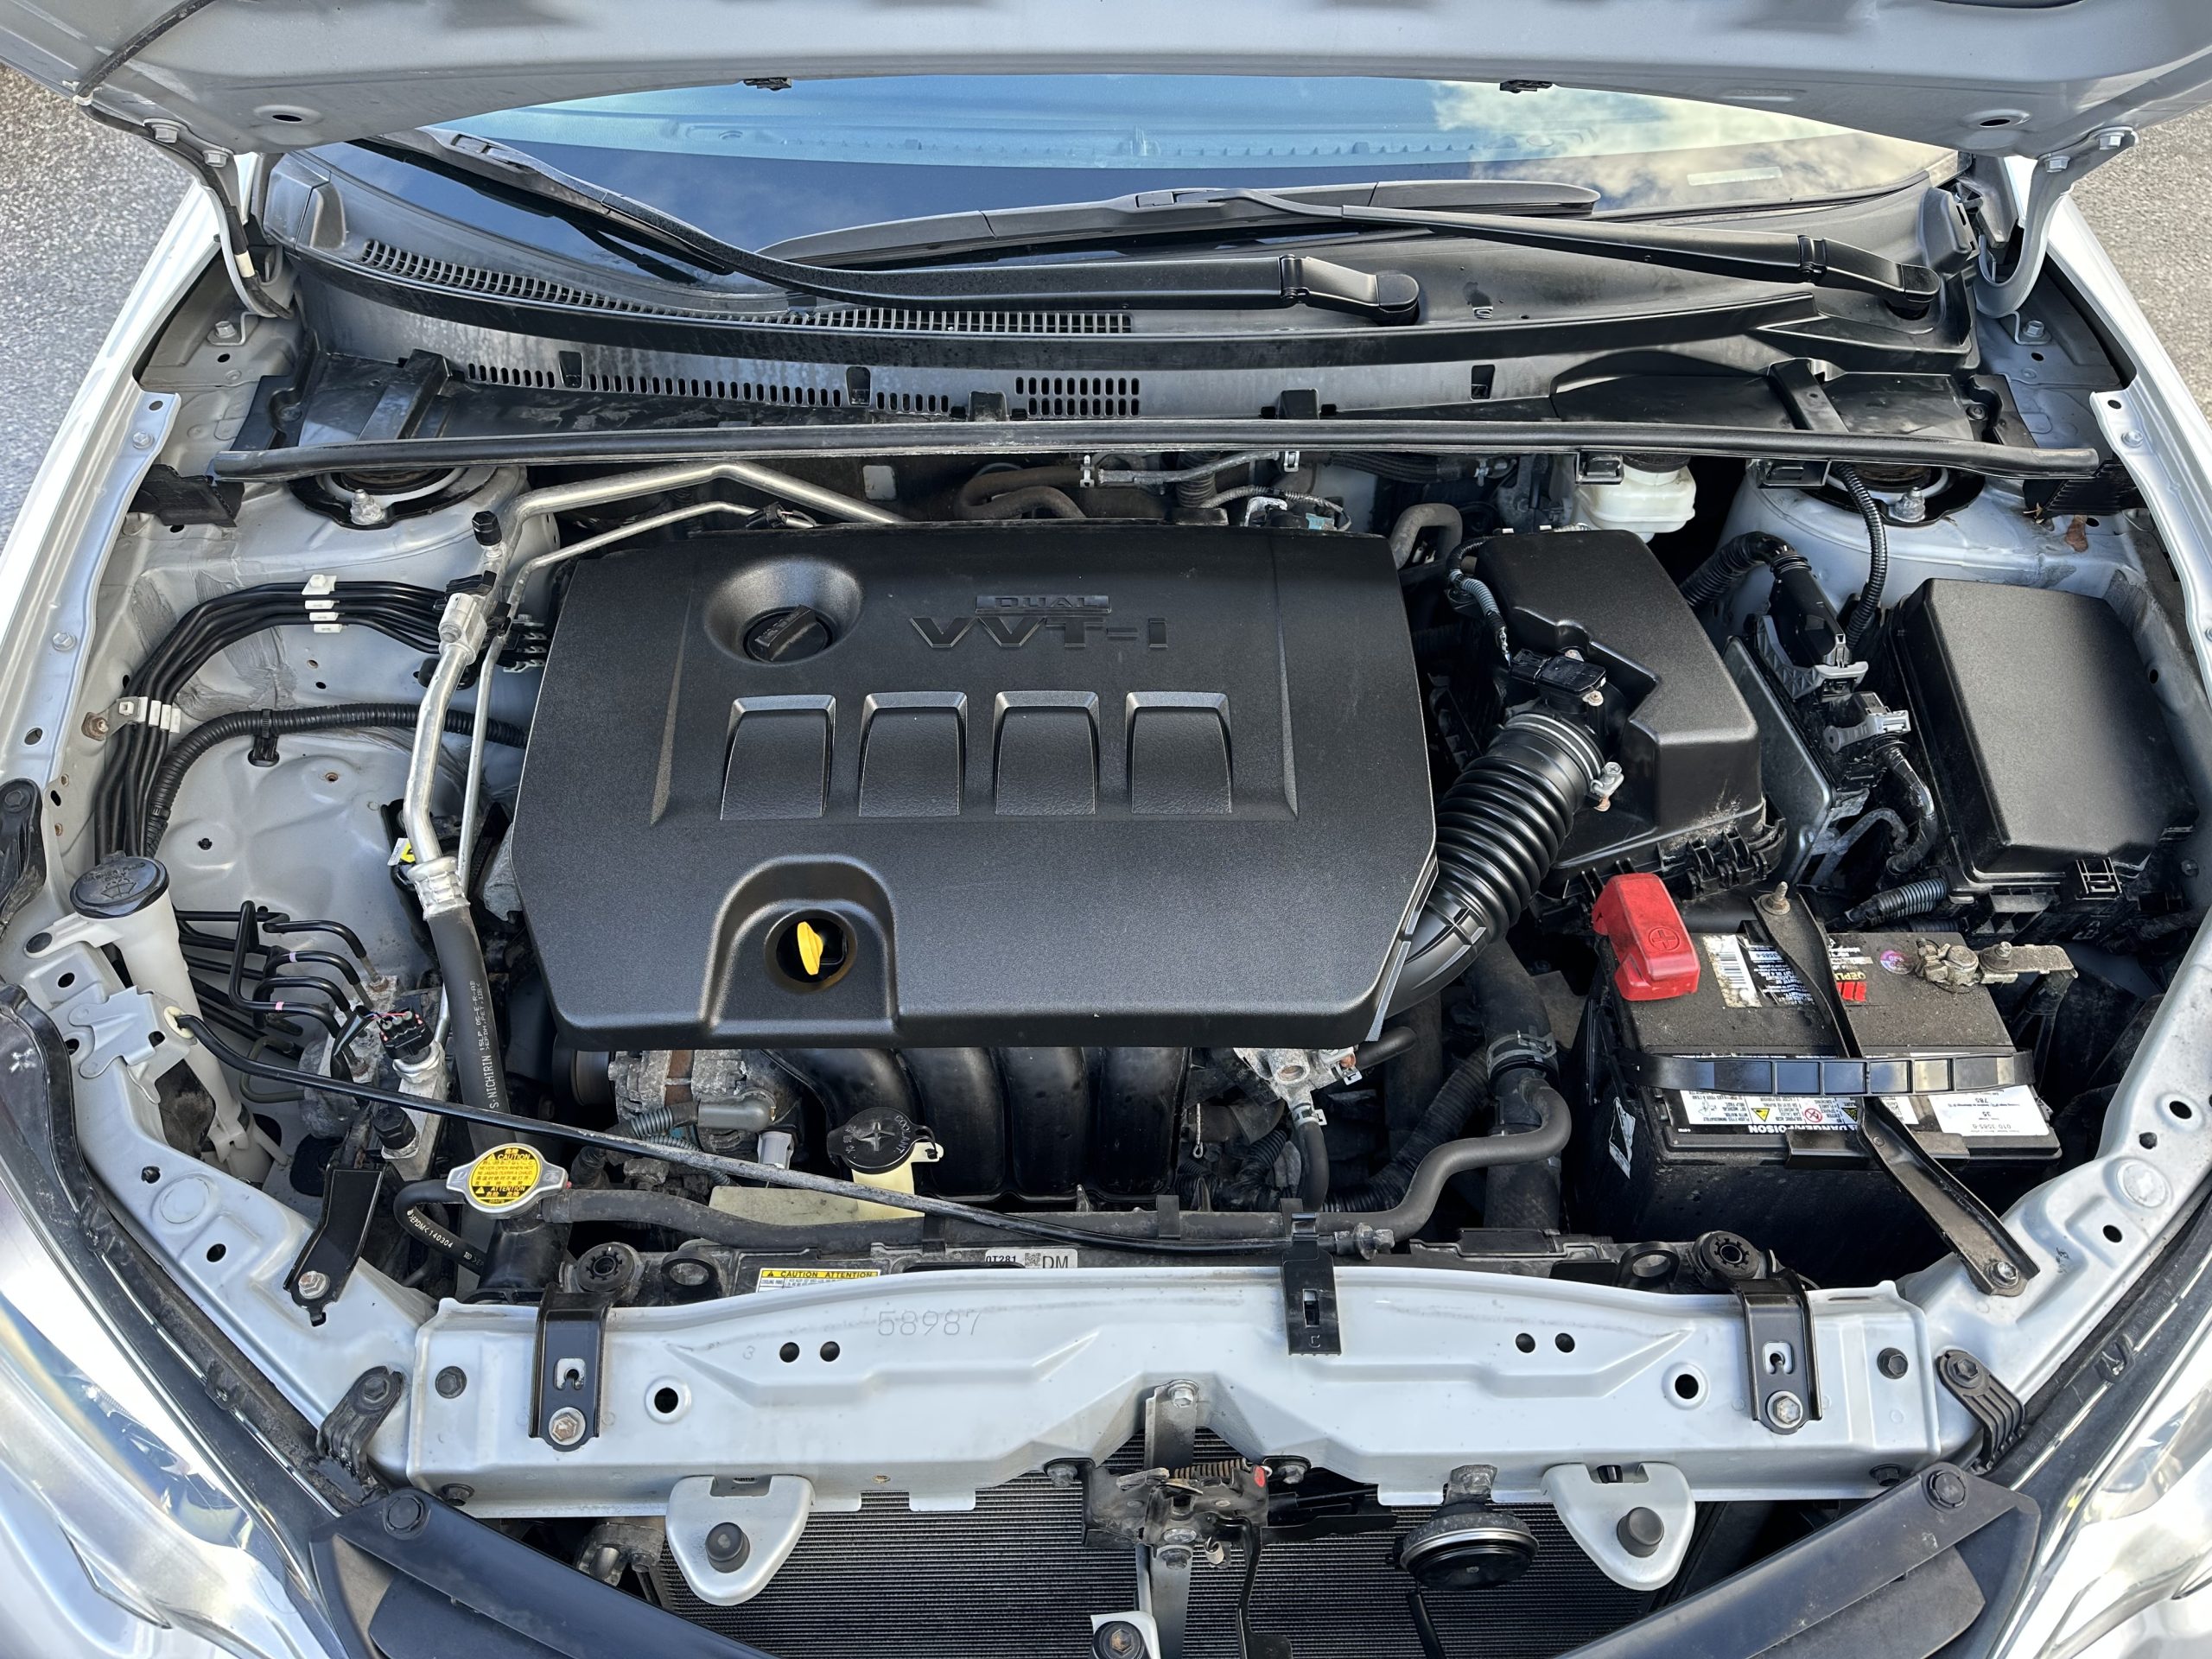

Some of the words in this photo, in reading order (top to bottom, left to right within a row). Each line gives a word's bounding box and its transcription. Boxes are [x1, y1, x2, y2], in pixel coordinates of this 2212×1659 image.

[995, 596, 1098, 608] DUAL
[429, 1230, 454, 1249] 140304
[1042, 1255, 1069, 1268] DM
[878, 1310, 982, 1337] 58987
